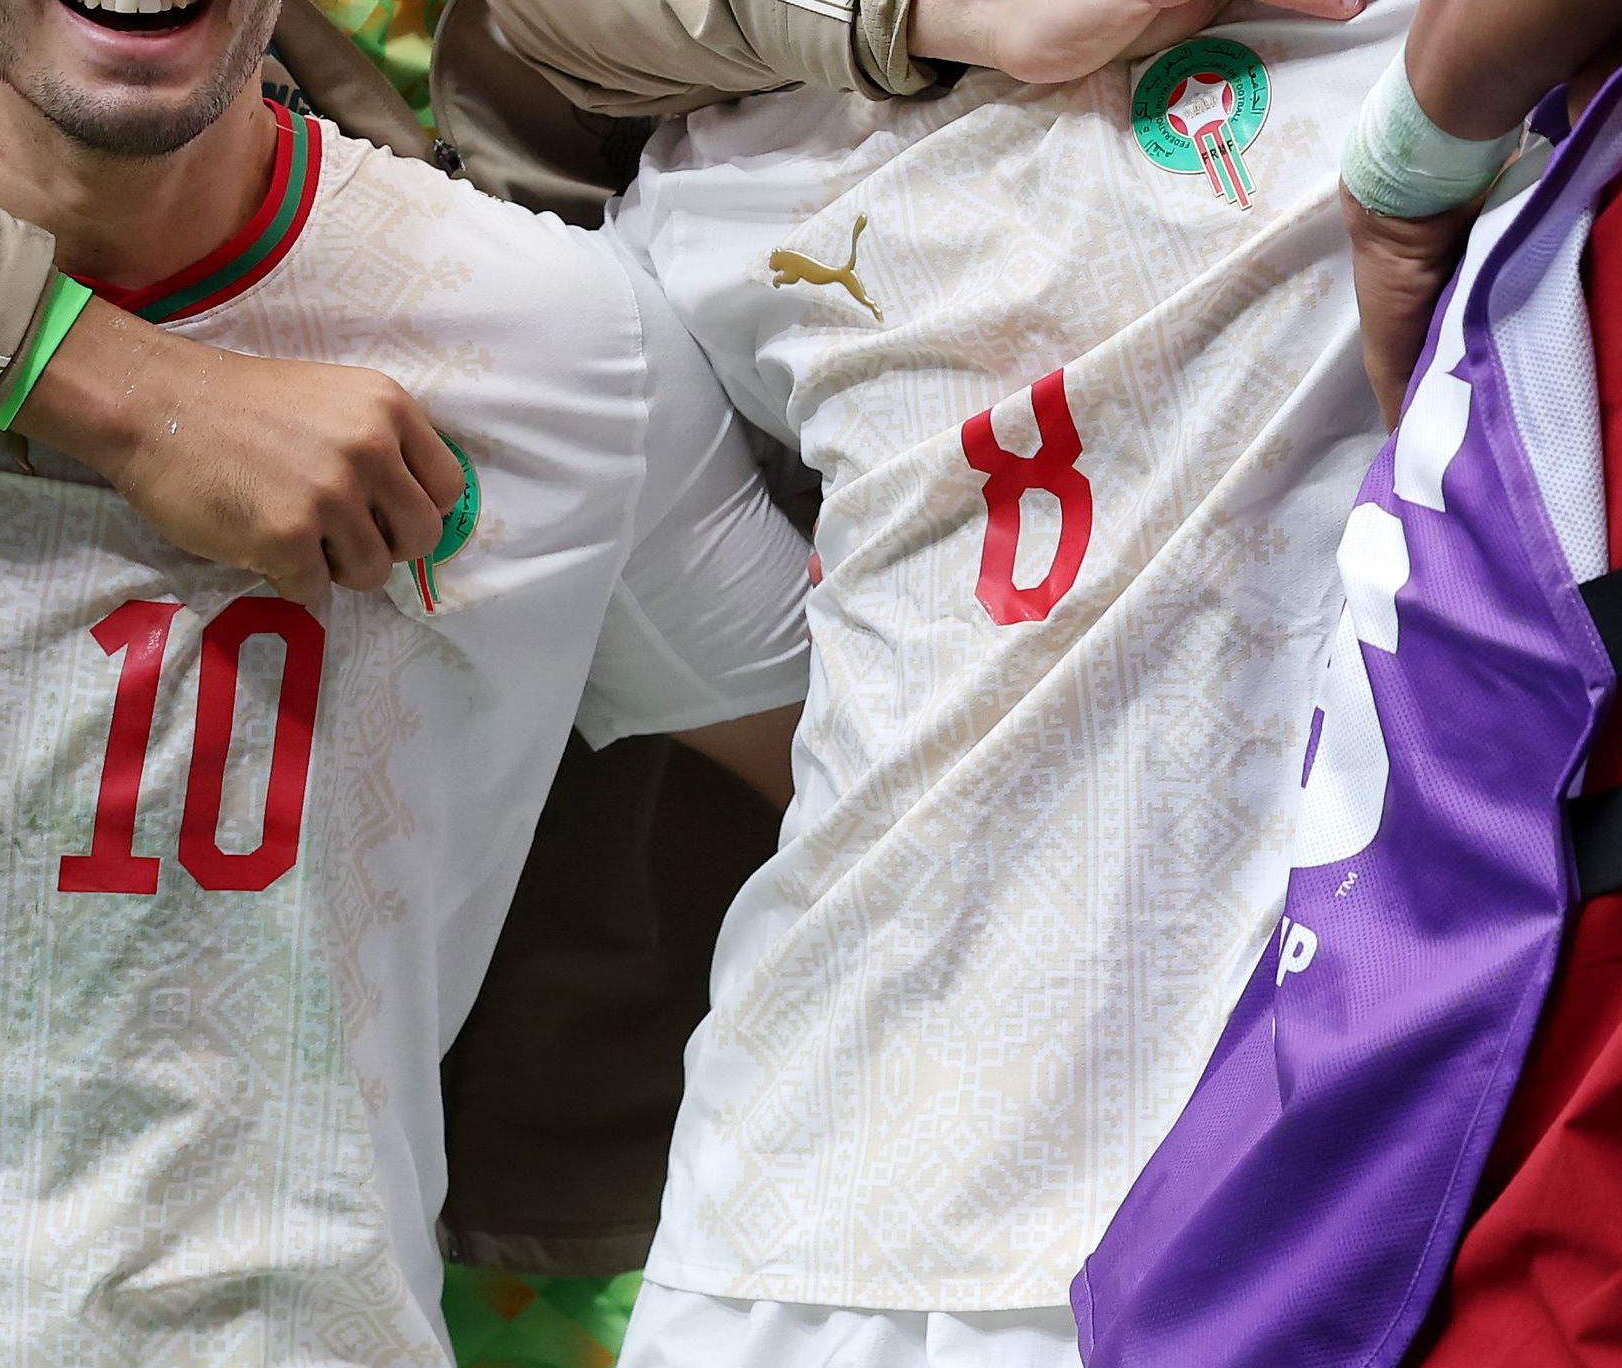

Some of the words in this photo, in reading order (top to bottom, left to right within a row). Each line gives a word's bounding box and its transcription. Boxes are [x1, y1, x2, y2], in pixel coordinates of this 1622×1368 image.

[961, 367, 1094, 626] 8
[58, 596, 326, 895] 10
[1276, 914, 1318, 987] P
[1334, 871, 1359, 899] TM
